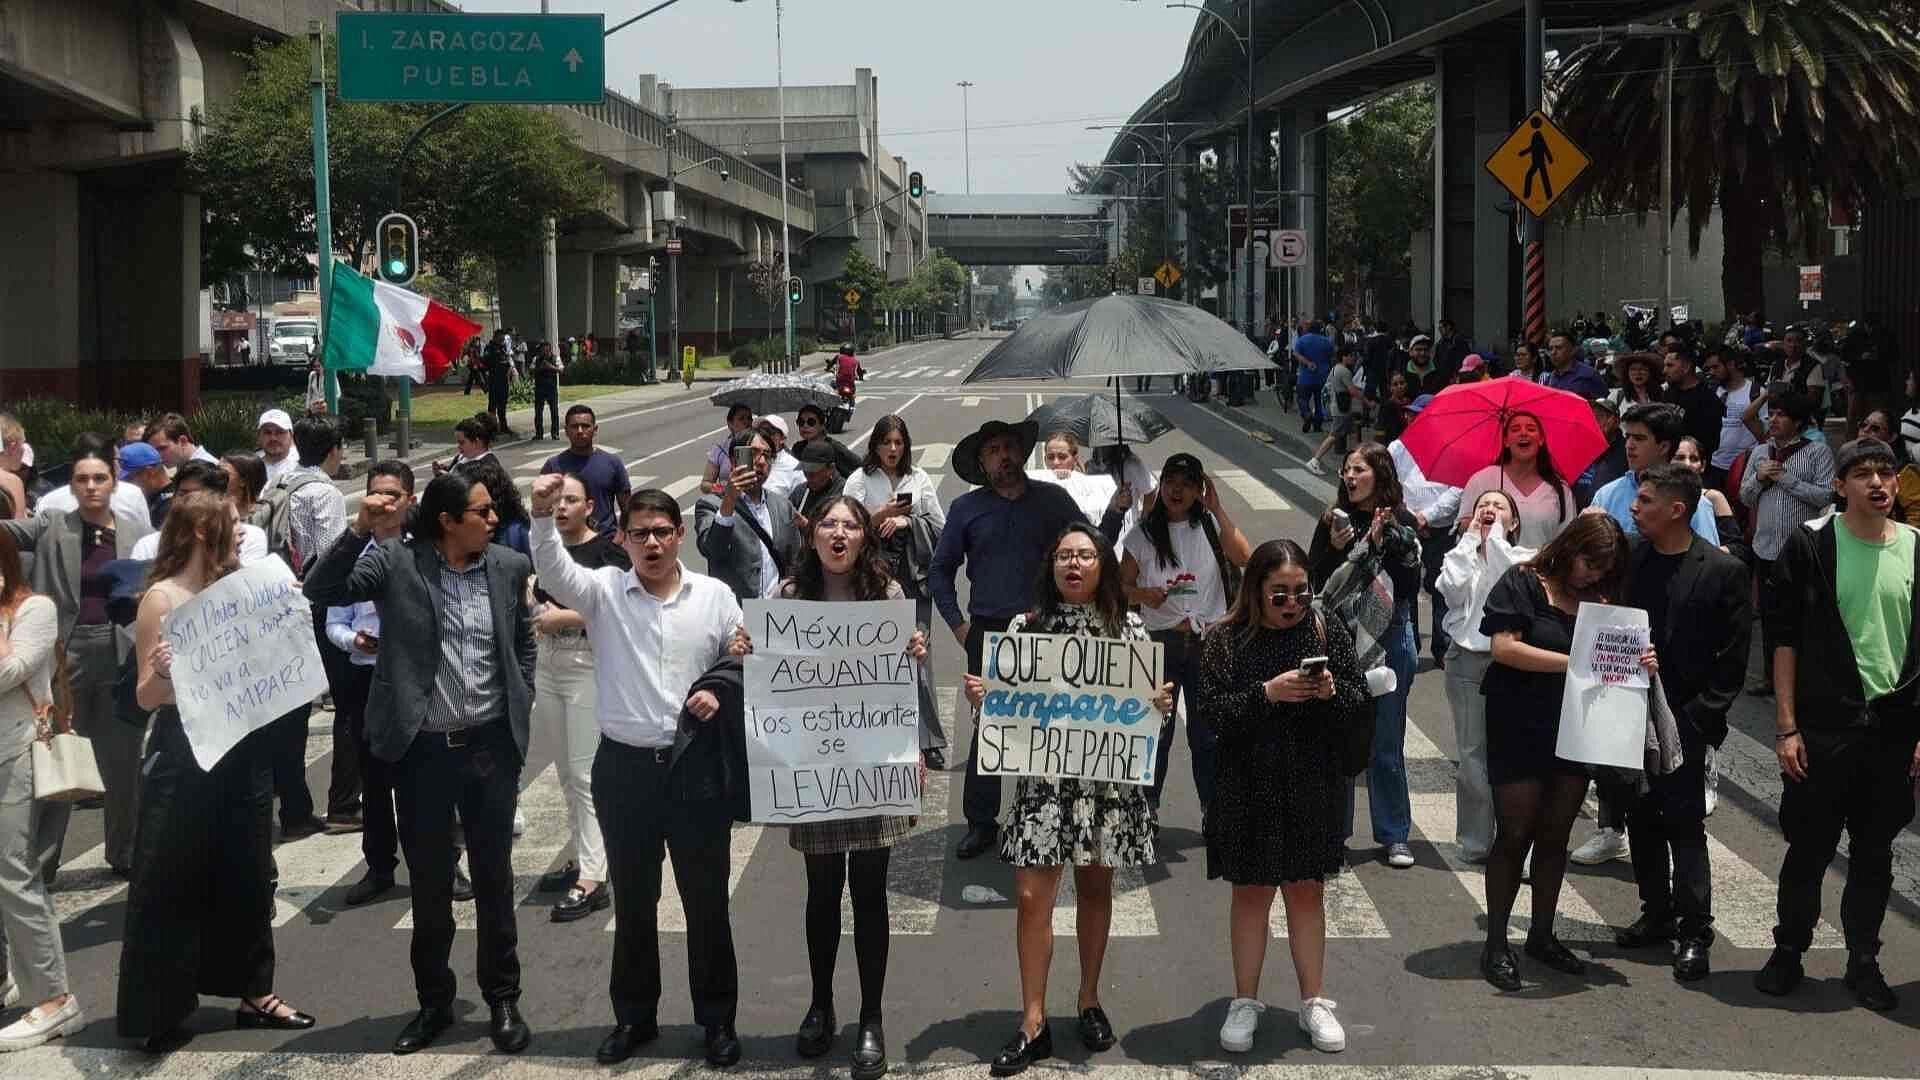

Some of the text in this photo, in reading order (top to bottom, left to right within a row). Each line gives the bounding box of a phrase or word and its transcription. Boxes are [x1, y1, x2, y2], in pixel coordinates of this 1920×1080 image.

[391, 30, 545, 51] ZARAGOZA
[403, 65, 532, 86] PUEBLA
[168, 617, 199, 651] Sin
[765, 610, 899, 650] México
[770, 652, 914, 688] AGUANTA
[987, 635, 1158, 690] ¡QUE QUIEN
[214, 671, 234, 692] va
[751, 704, 792, 737] los
[984, 689, 1151, 728] ampare
[816, 737, 847, 755] se
[980, 724, 1155, 781] SE PREPARE!
[770, 765, 919, 809] LEVANTAN
